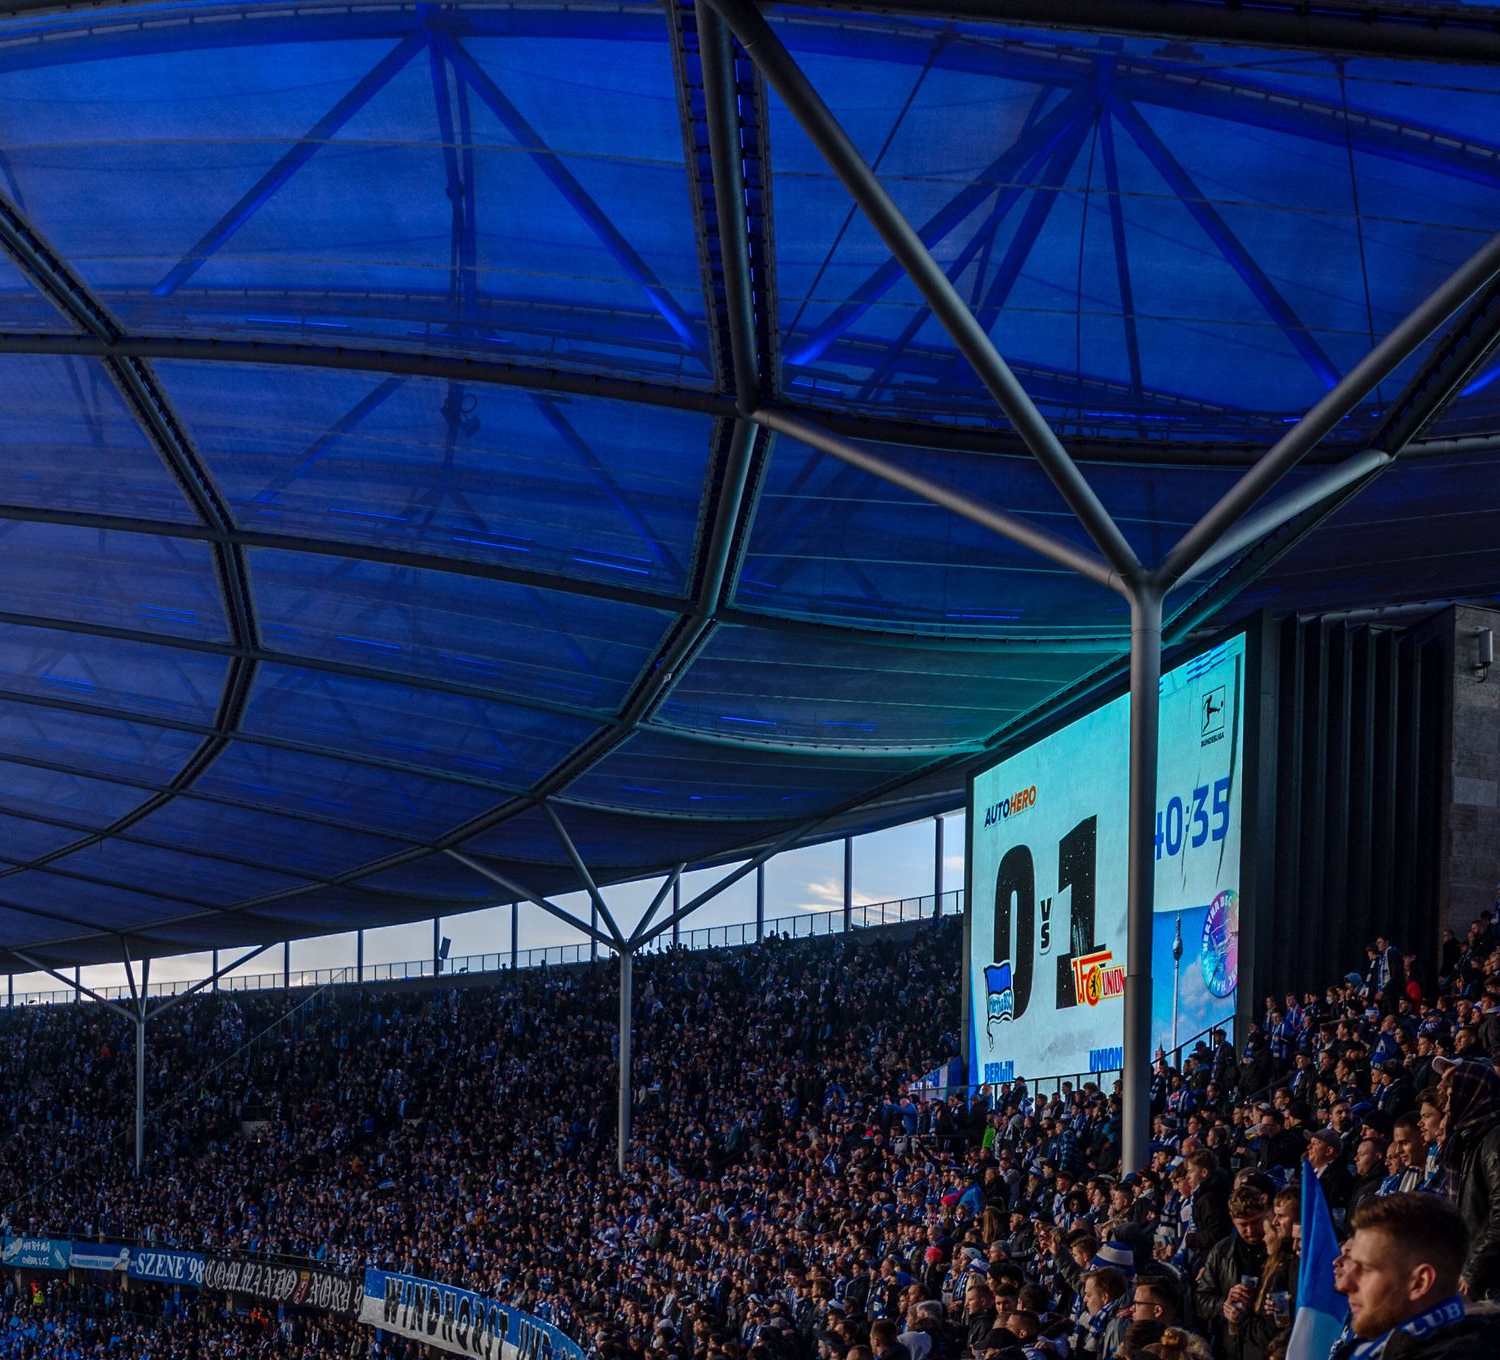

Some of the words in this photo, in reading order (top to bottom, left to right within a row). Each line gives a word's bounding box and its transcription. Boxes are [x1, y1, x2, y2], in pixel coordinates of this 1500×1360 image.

[1201, 732, 1226, 749] BUNDESLIGA
[983, 785, 1038, 829] AUTOHERO
[1056, 814, 1098, 1010] 1
[1089, 1047, 1123, 1072] UNION
[137, 1252, 204, 1284] SZENE'98
[205, 1259, 297, 1301] COMMANDO
[1404, 1301, 1462, 1339] LUB
